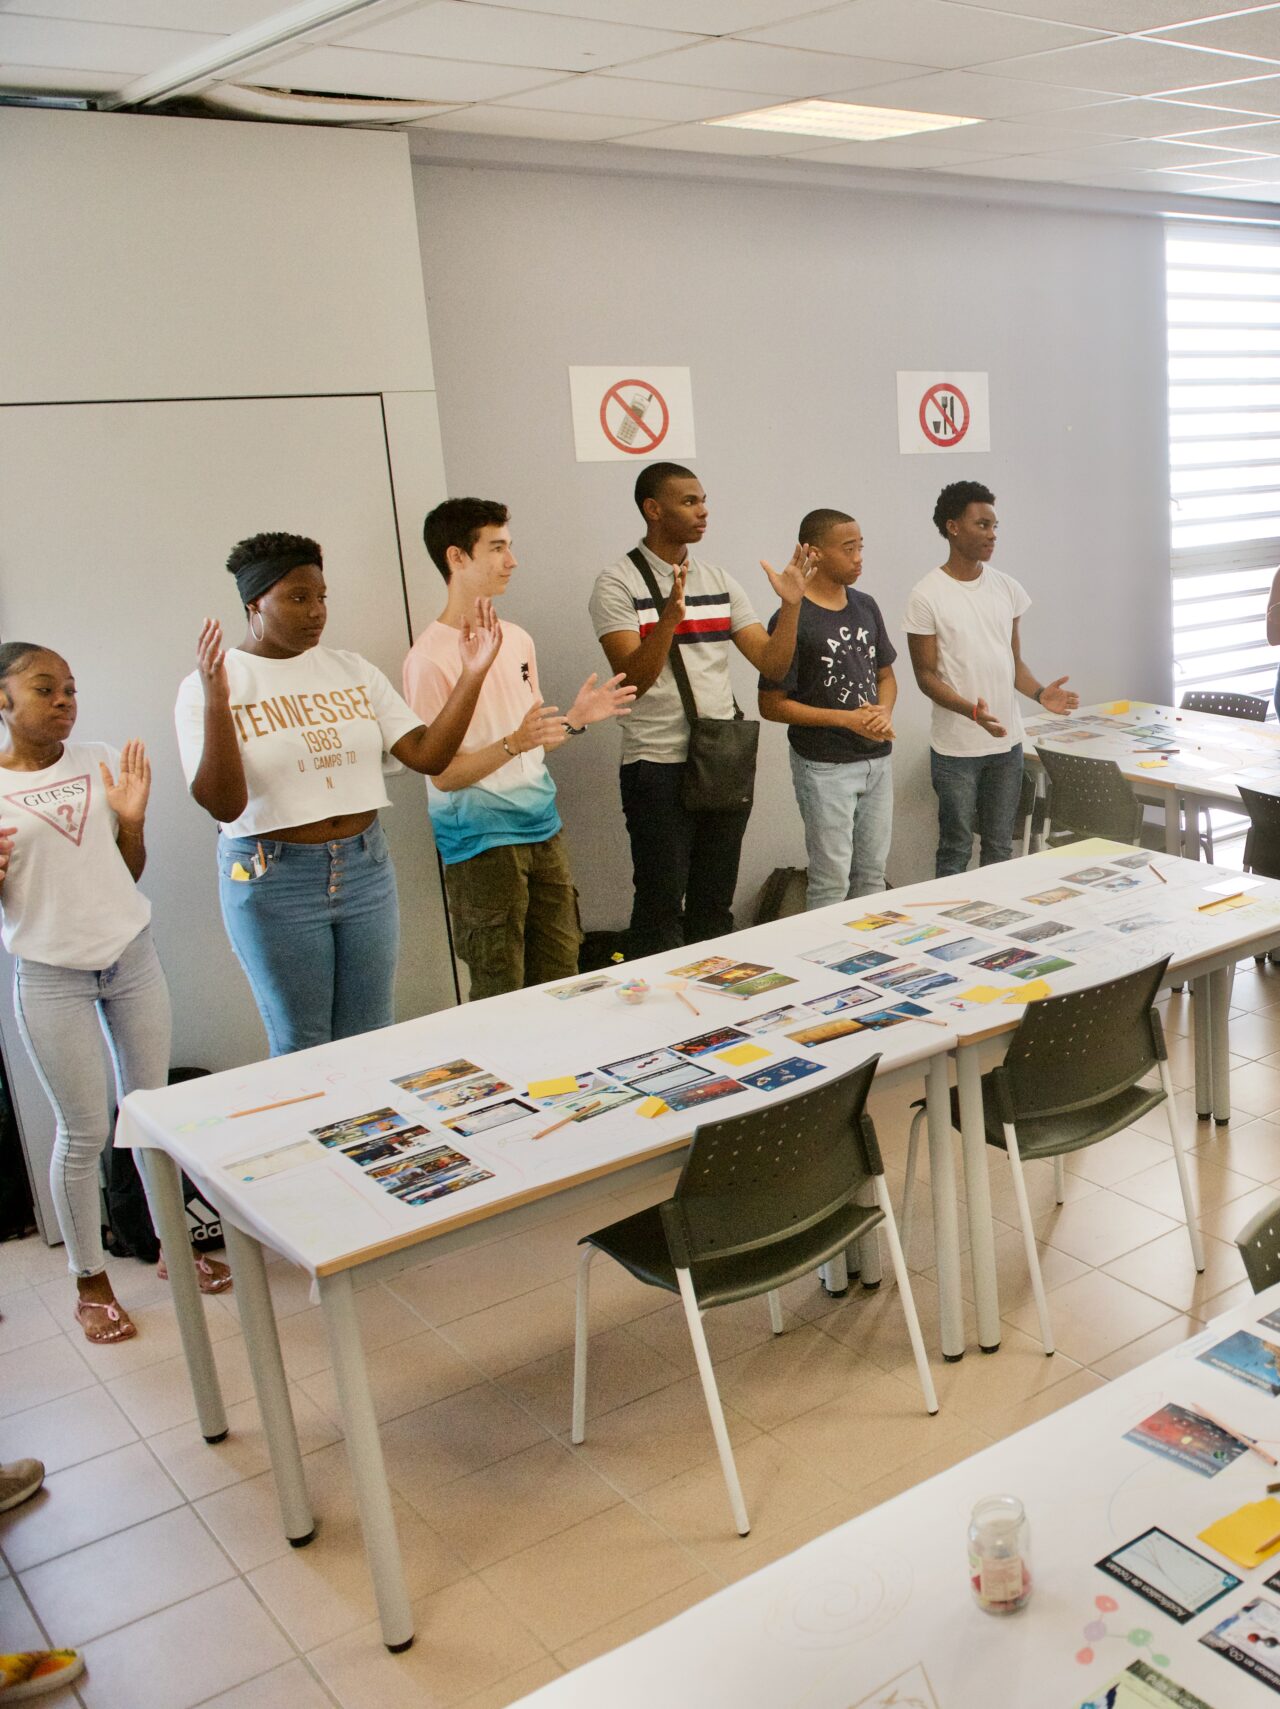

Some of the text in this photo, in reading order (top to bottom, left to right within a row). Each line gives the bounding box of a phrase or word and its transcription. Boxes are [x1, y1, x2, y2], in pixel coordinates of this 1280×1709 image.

[230, 685, 376, 743] TENNESSEE
[301, 727, 343, 754] 1983
[313, 753, 342, 770] CAMPS
[23, 783, 85, 807] GUESS
[1104, 1559, 1186, 1619] Acidification de l'océan
[1243, 1656, 1255, 1668] en
